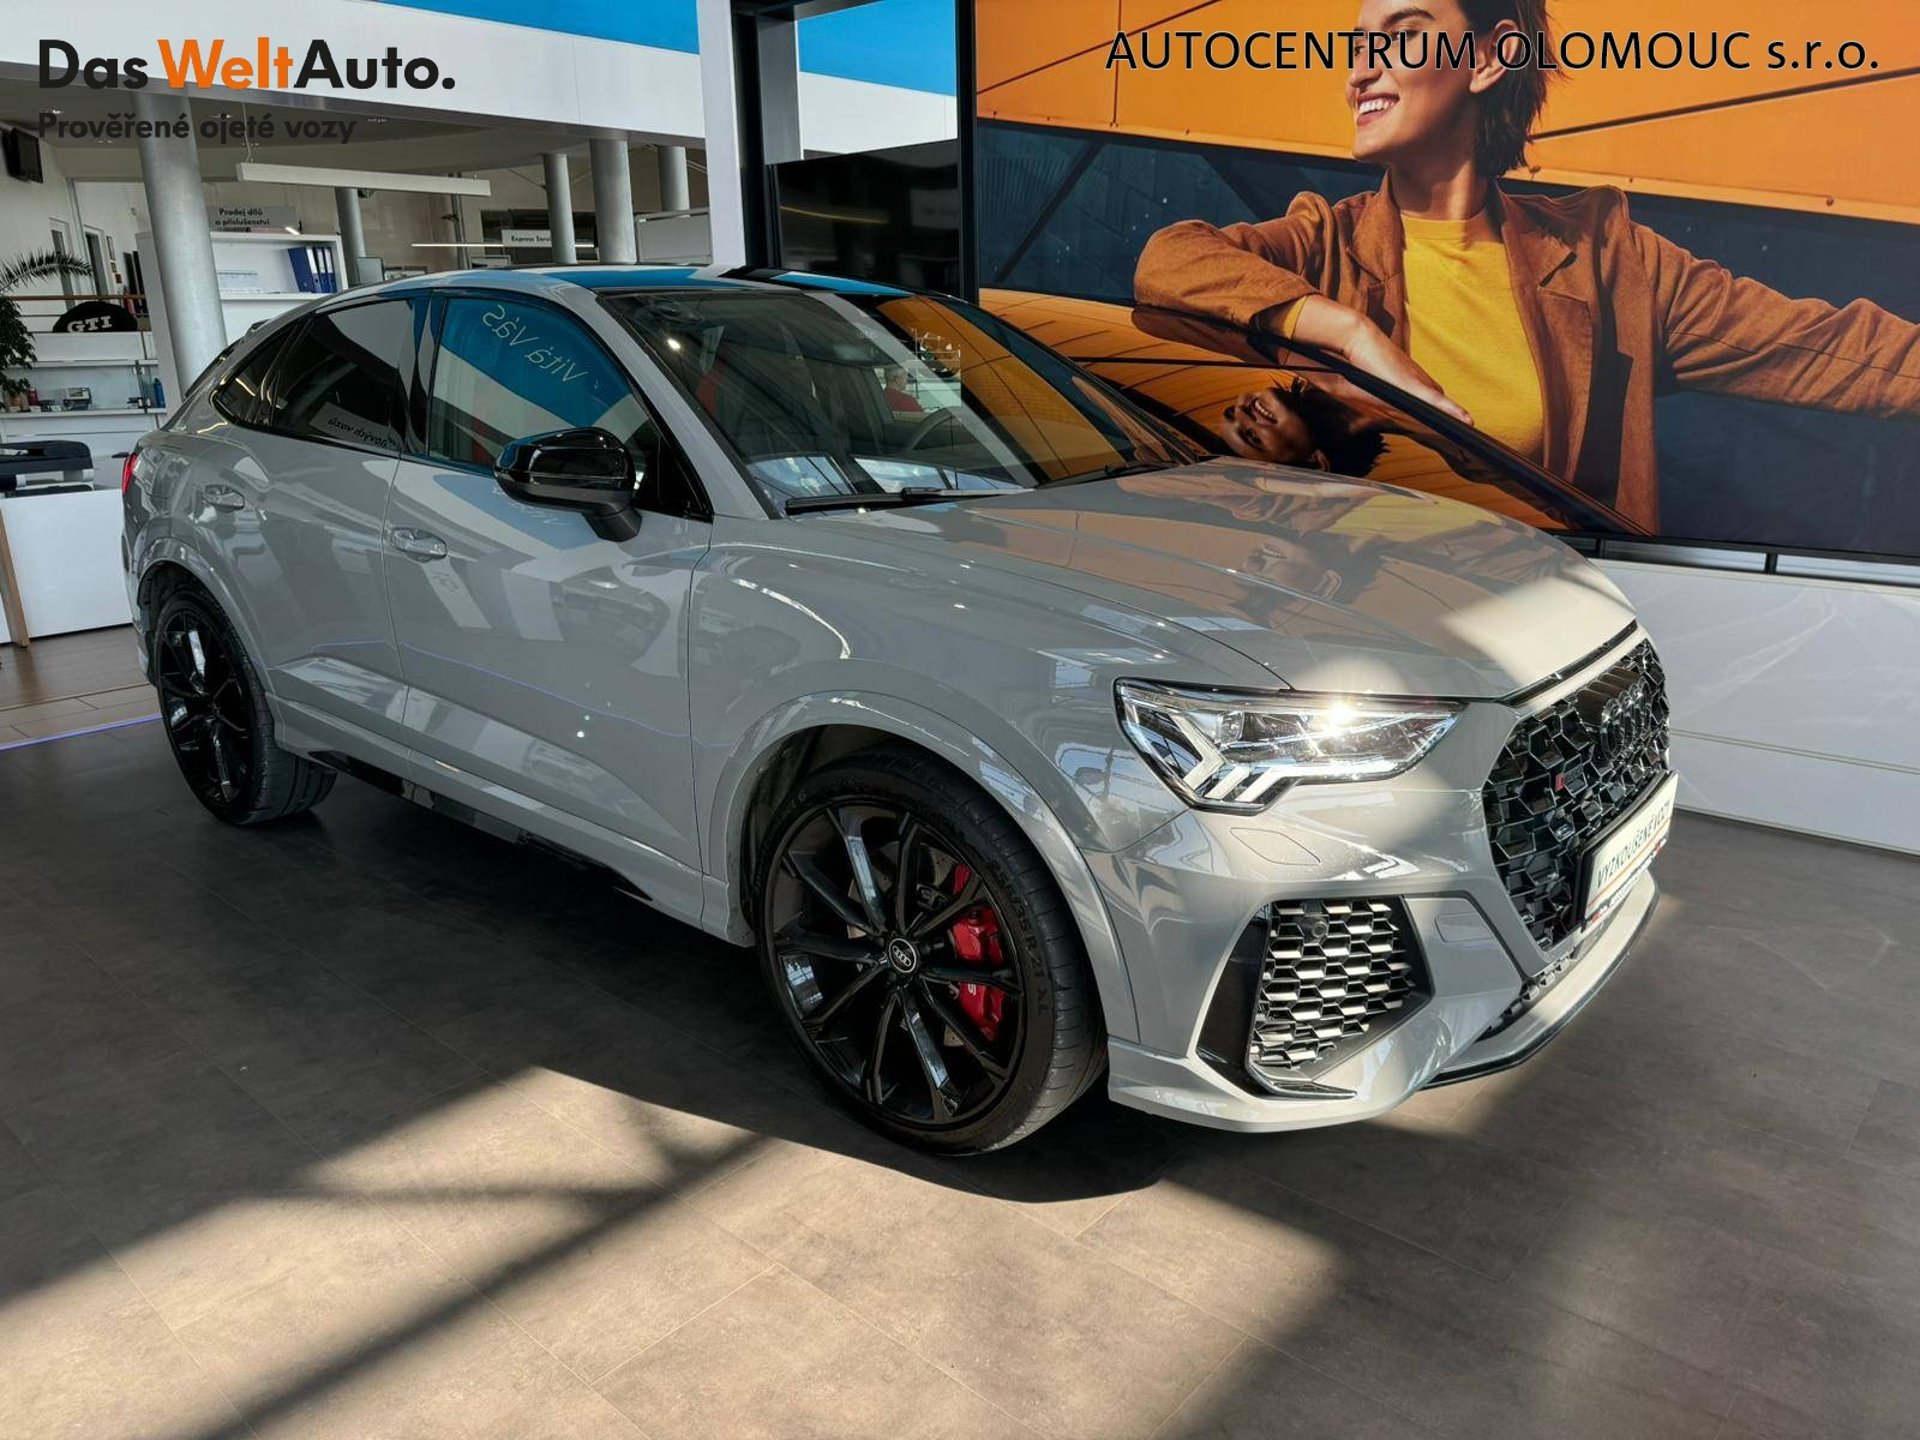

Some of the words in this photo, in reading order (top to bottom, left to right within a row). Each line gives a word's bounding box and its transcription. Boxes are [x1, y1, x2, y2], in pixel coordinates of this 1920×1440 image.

[219, 208, 245, 217] Prodej
[511, 235, 534, 243] Express
[66, 315, 113, 333] GTI
